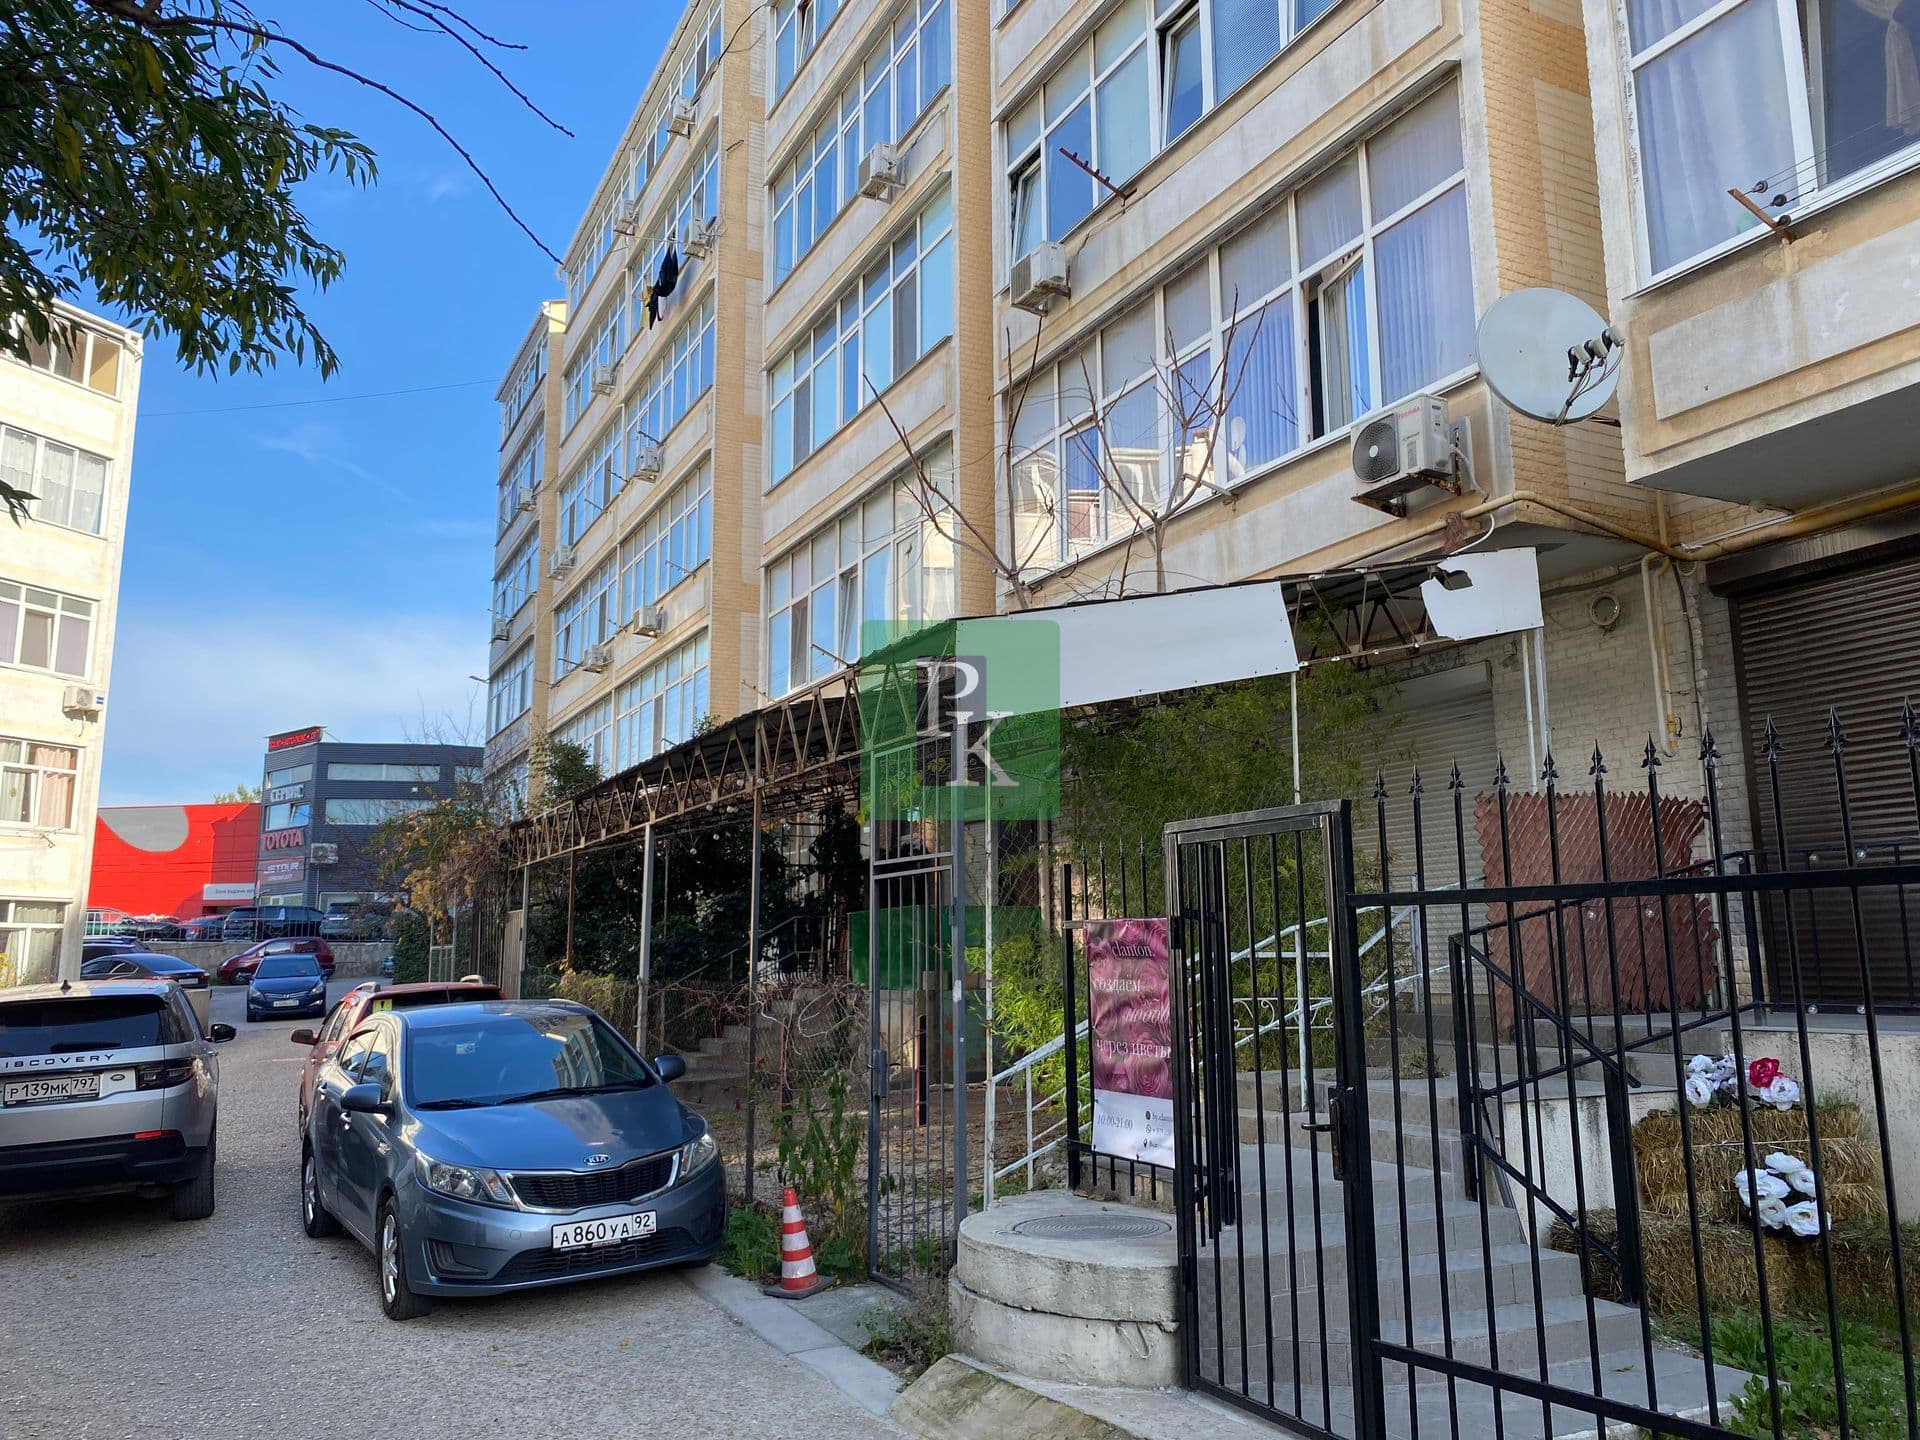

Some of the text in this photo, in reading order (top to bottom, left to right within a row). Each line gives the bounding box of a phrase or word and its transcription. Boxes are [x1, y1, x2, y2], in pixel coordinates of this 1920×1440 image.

[263, 828, 303, 851] TOYOTA
[1093, 974, 1141, 993] создаём
[1096, 1039, 1129, 1058] через
